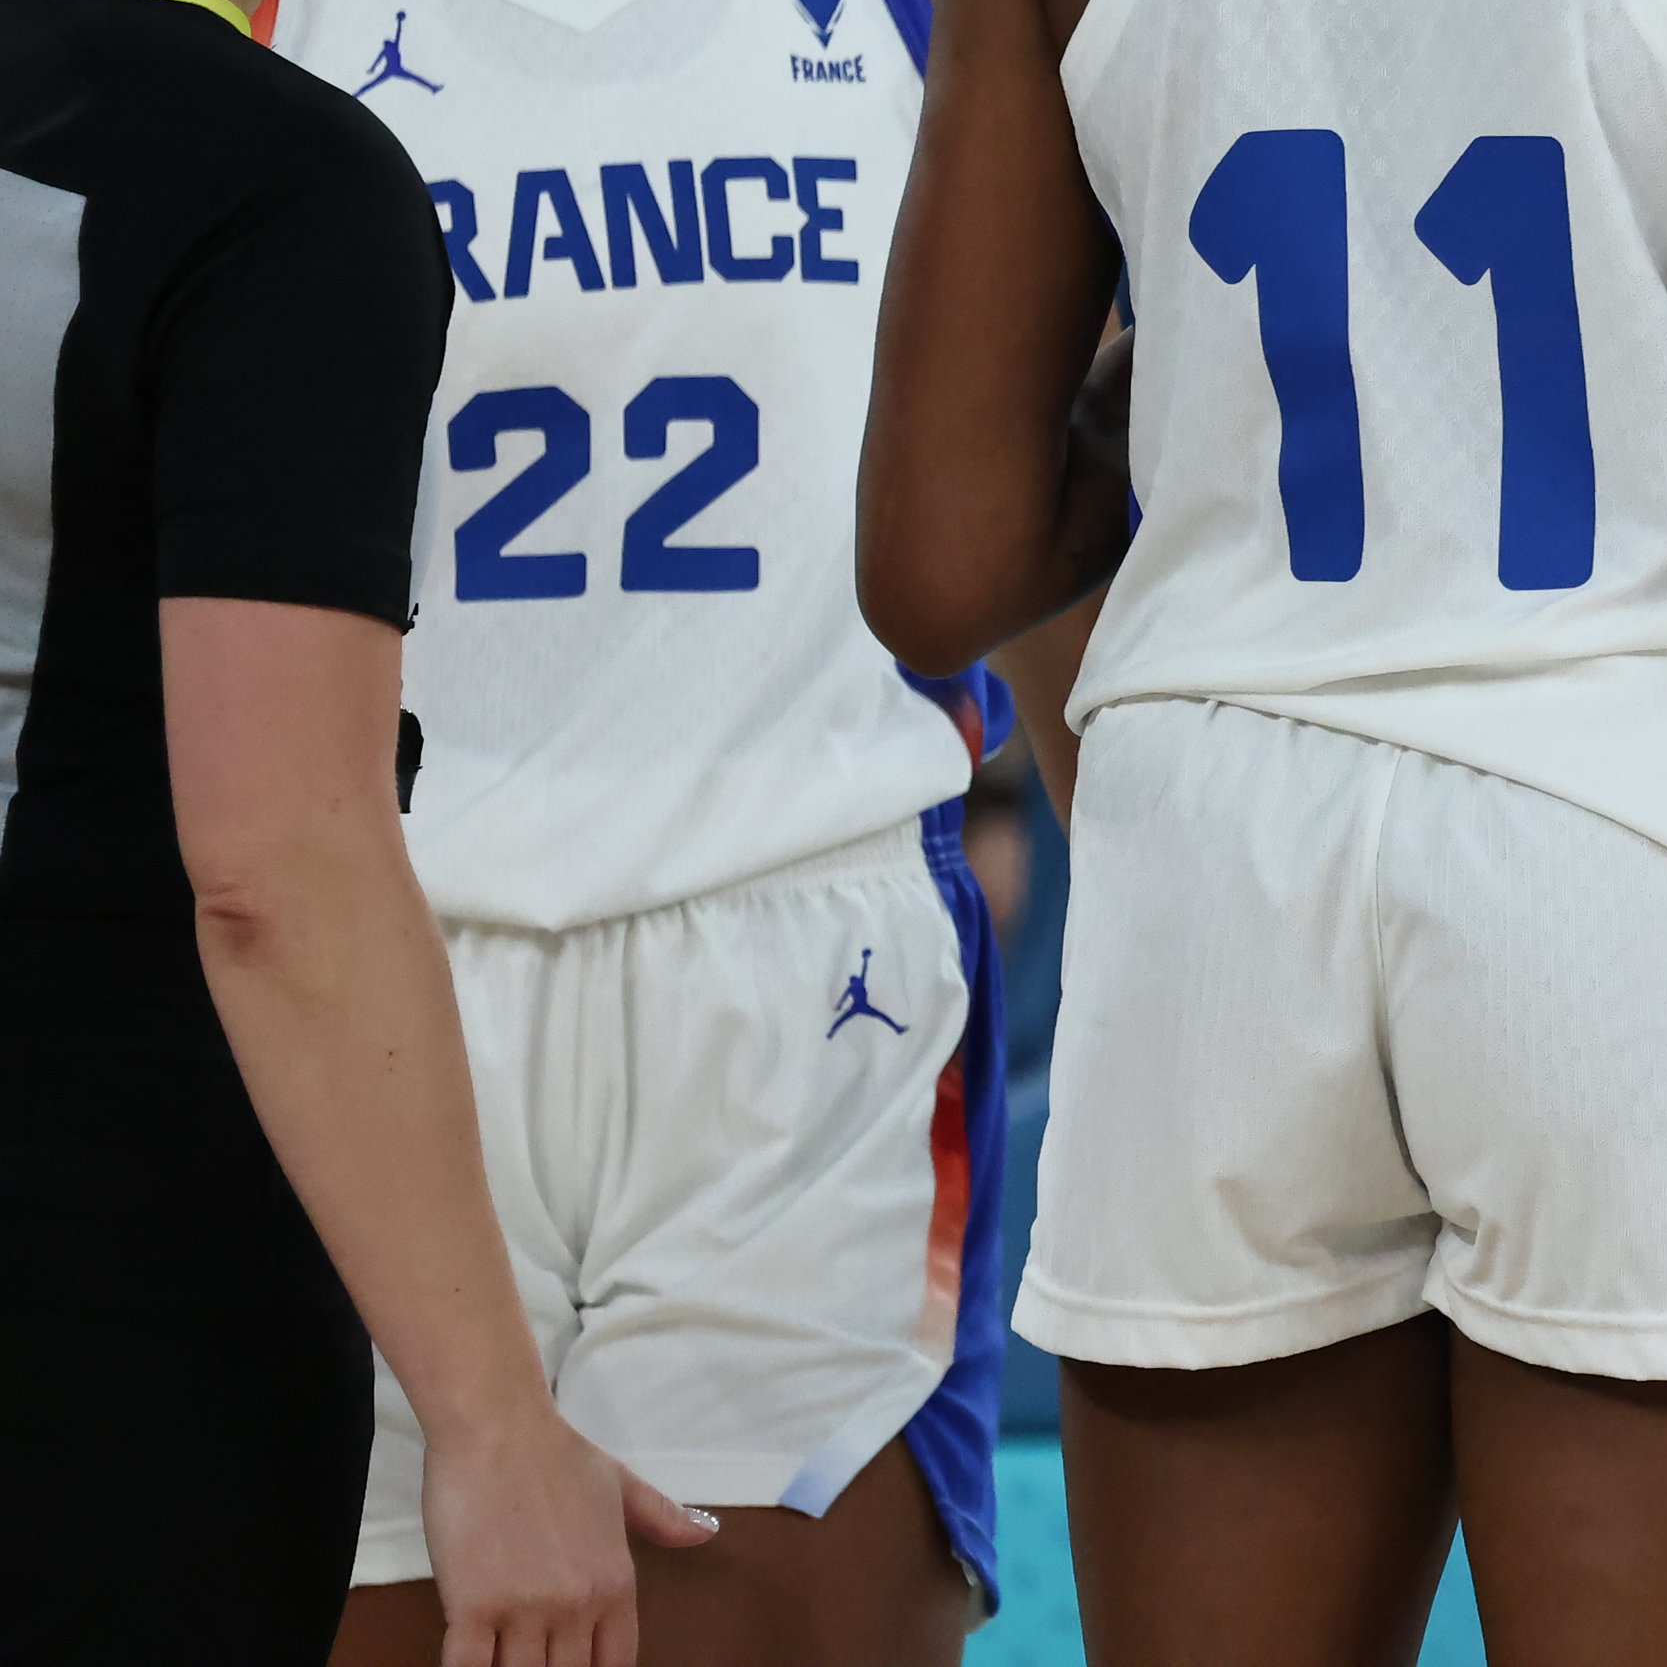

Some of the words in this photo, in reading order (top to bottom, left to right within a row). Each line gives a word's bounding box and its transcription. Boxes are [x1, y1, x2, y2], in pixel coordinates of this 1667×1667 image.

[789, 54, 866, 85] FRANCE
[425, 156, 859, 302] RANCE
[1188, 128, 1597, 591] 11
[447, 375, 760, 602] 22
